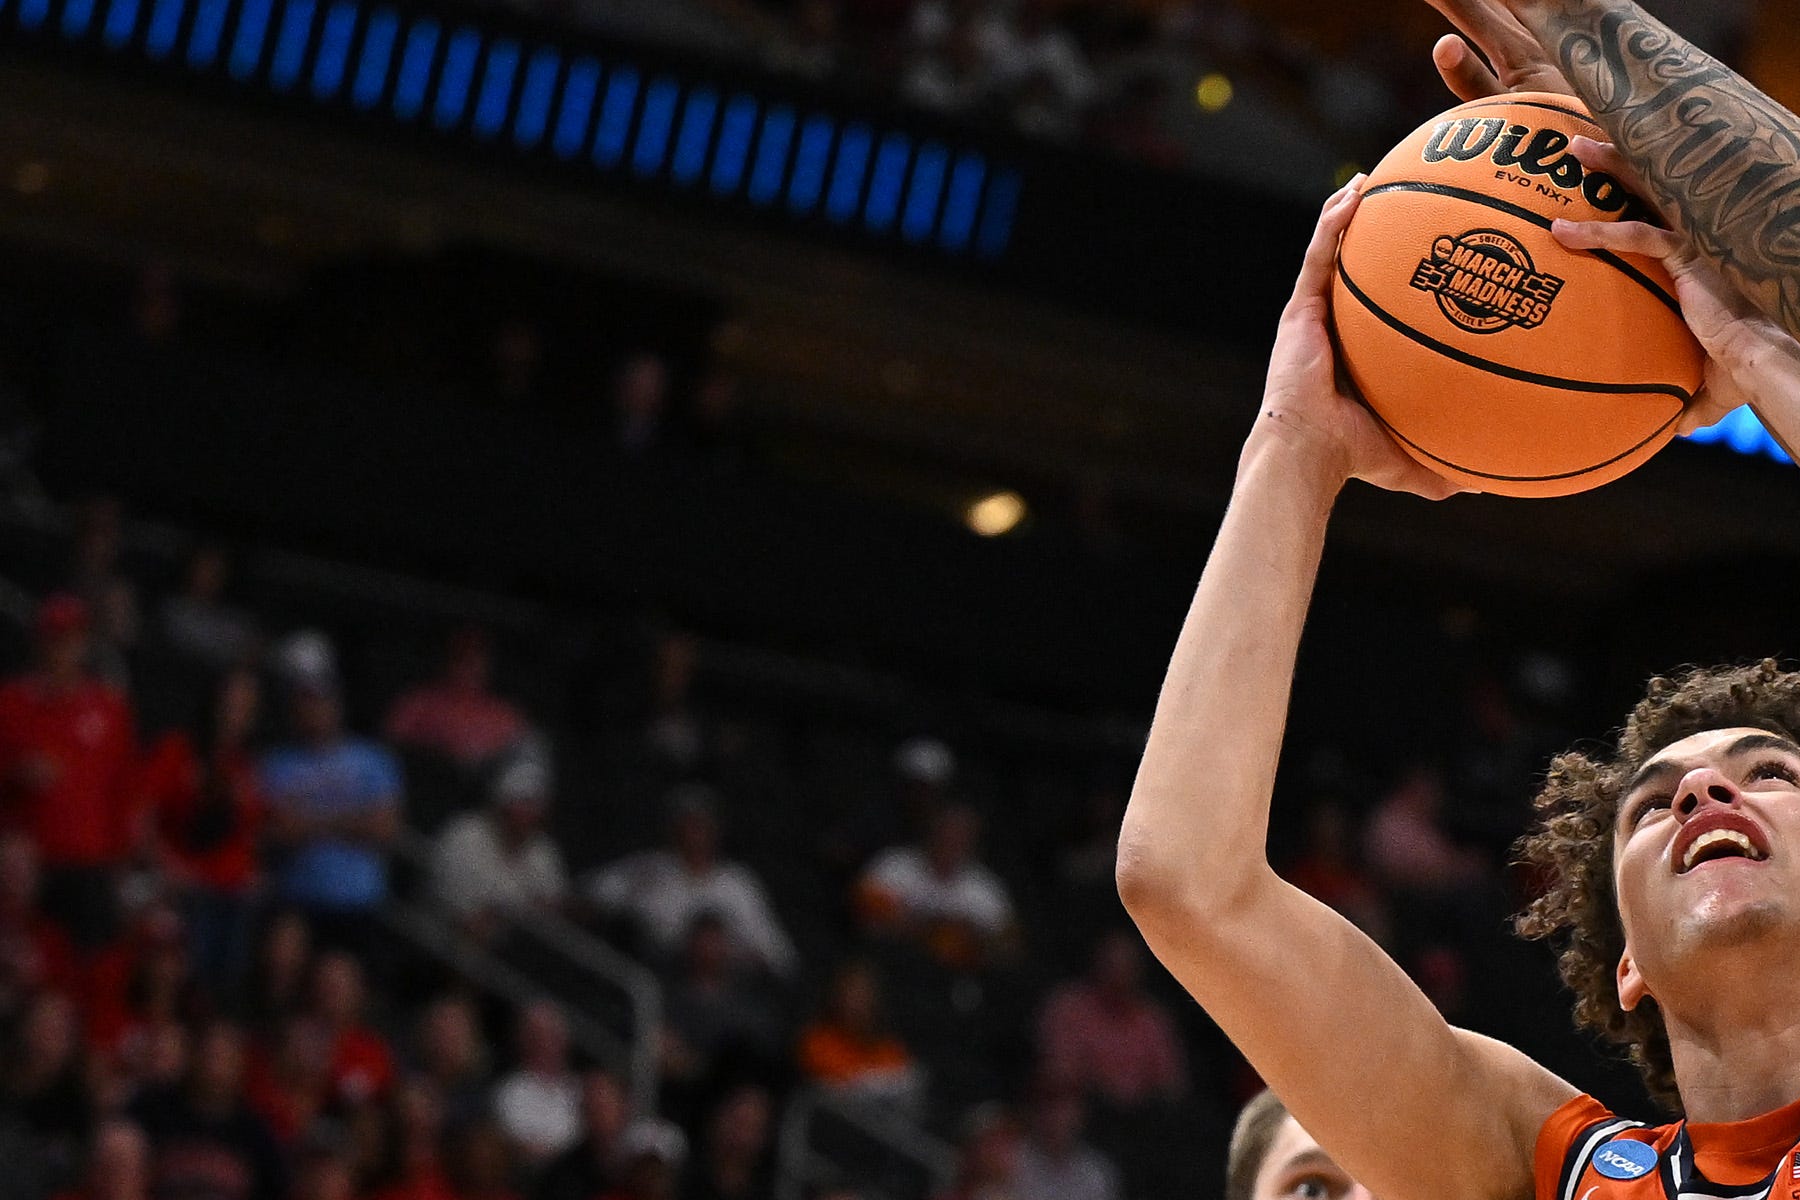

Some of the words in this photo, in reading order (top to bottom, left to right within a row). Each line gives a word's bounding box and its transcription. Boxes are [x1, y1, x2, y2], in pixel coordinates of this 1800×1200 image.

[1422, 117, 1638, 221] Wilso
[1494, 170, 1530, 188] EVO
[1535, 183, 1574, 207] NXT
[1450, 245, 1525, 289] MARCH
[1449, 270, 1548, 324] MADNESS
[1599, 1150, 1646, 1177] NCAA
